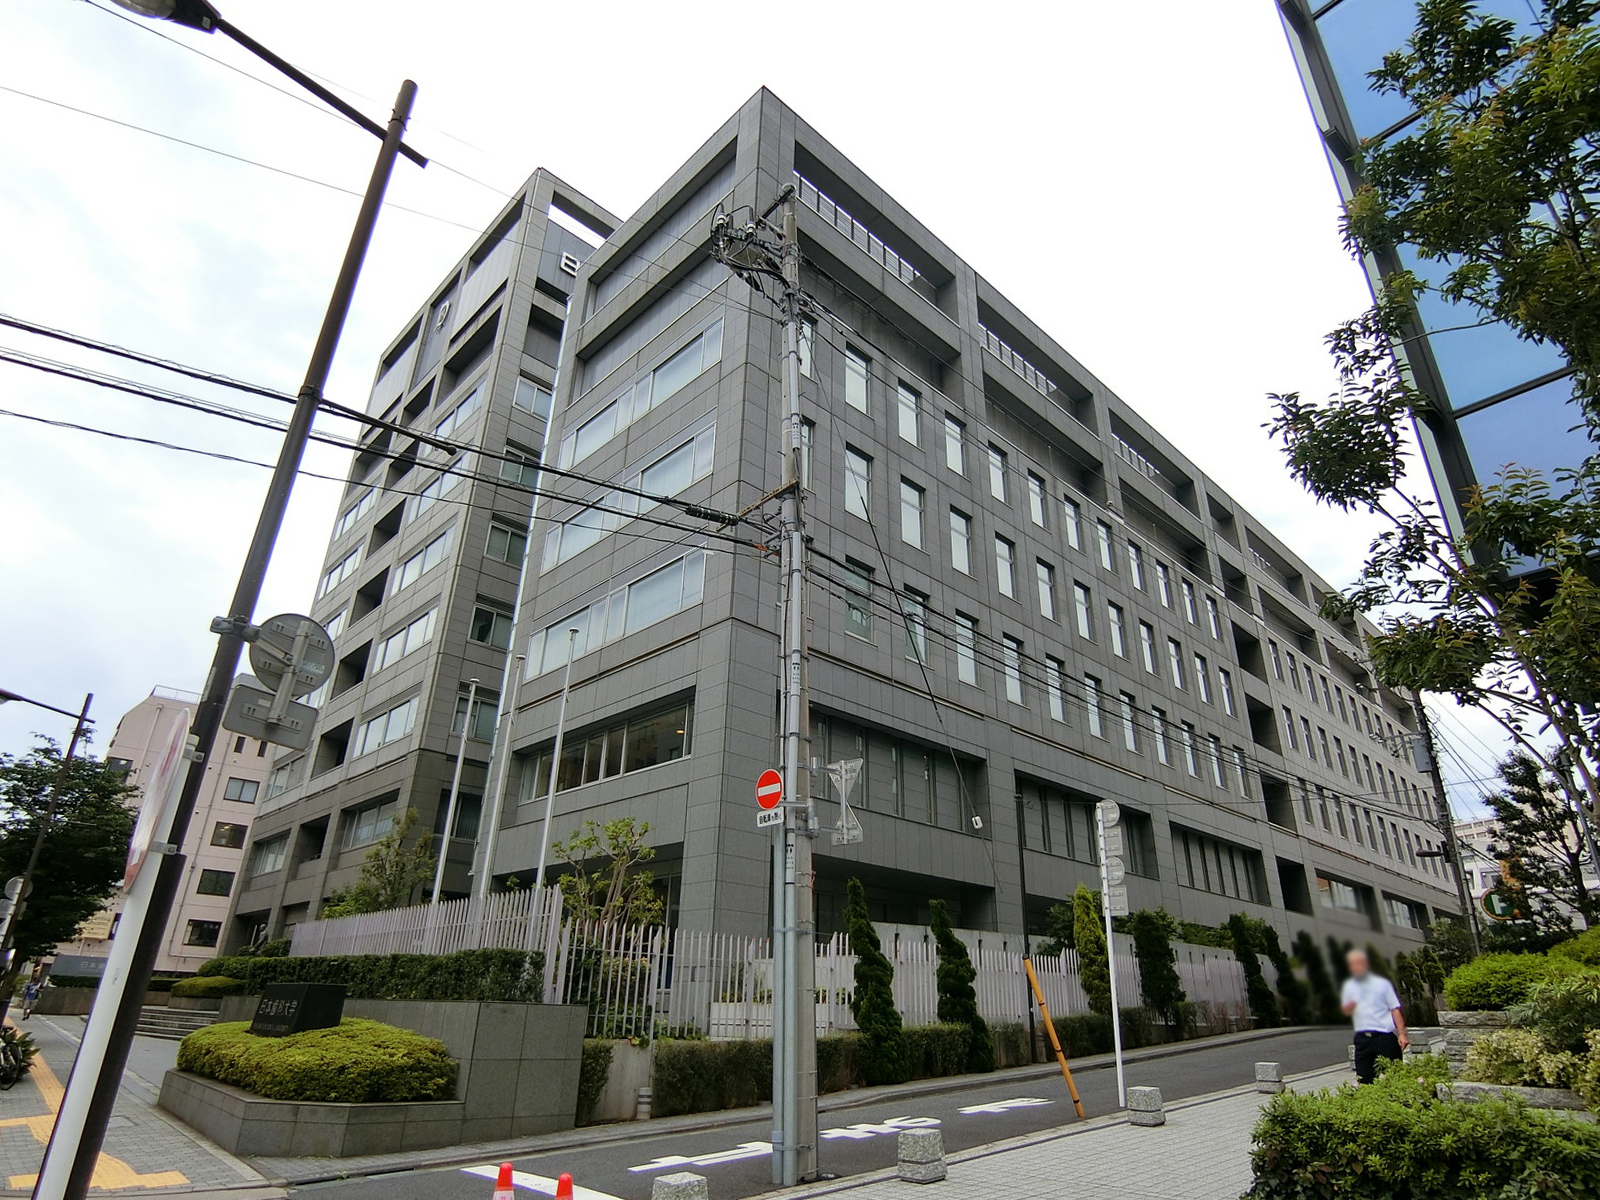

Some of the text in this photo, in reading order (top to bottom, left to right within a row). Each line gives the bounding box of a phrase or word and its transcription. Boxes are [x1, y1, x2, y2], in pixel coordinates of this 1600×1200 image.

[258, 998, 298, 1017] 日本歯科大学
